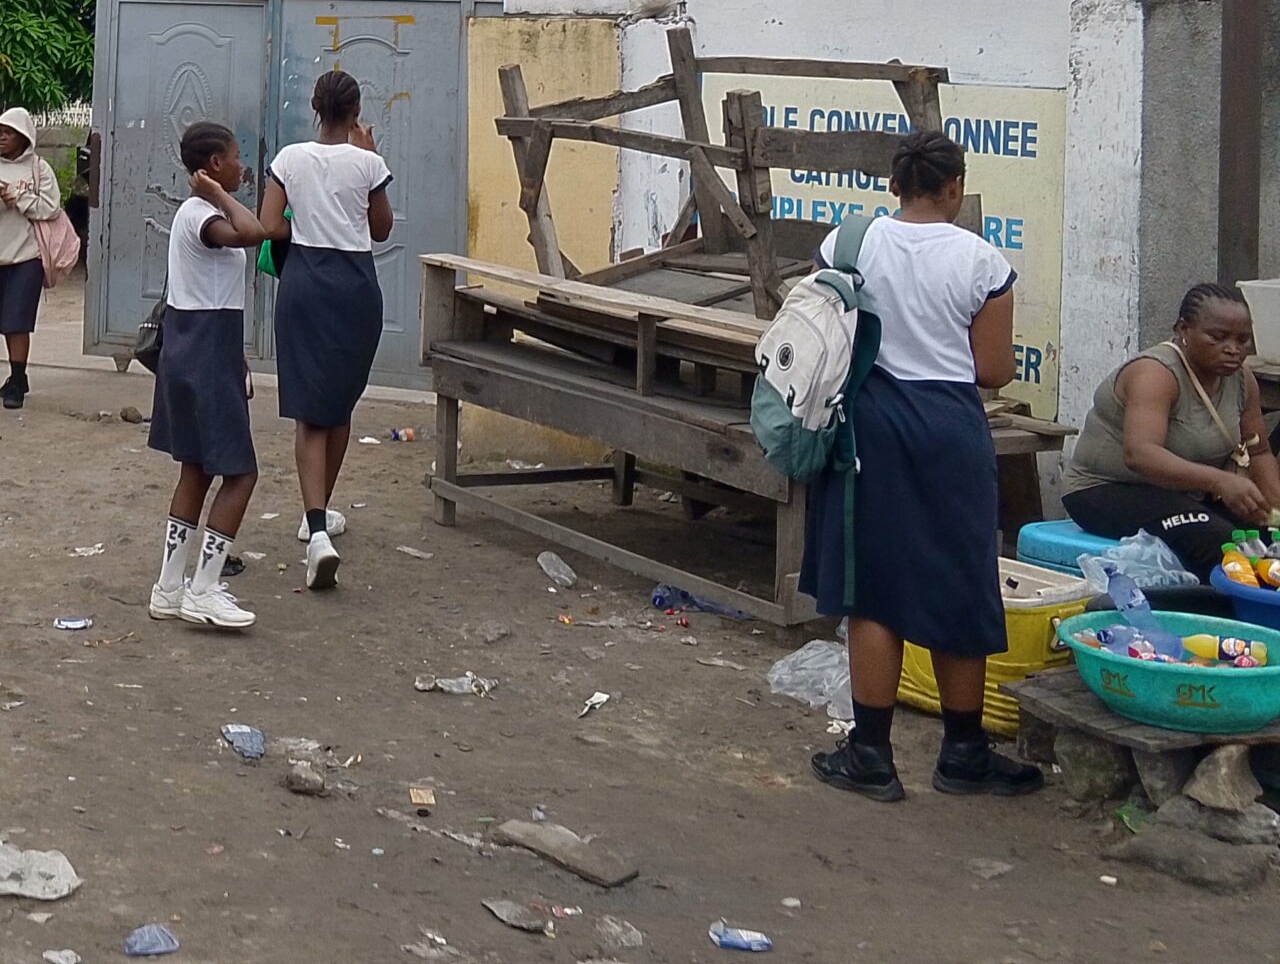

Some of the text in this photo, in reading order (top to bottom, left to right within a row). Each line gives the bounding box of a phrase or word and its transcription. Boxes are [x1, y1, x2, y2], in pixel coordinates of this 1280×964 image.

[1161, 512, 1210, 531] HELLO
[169, 523, 187, 544] 24
[206, 535, 226, 554] 24
